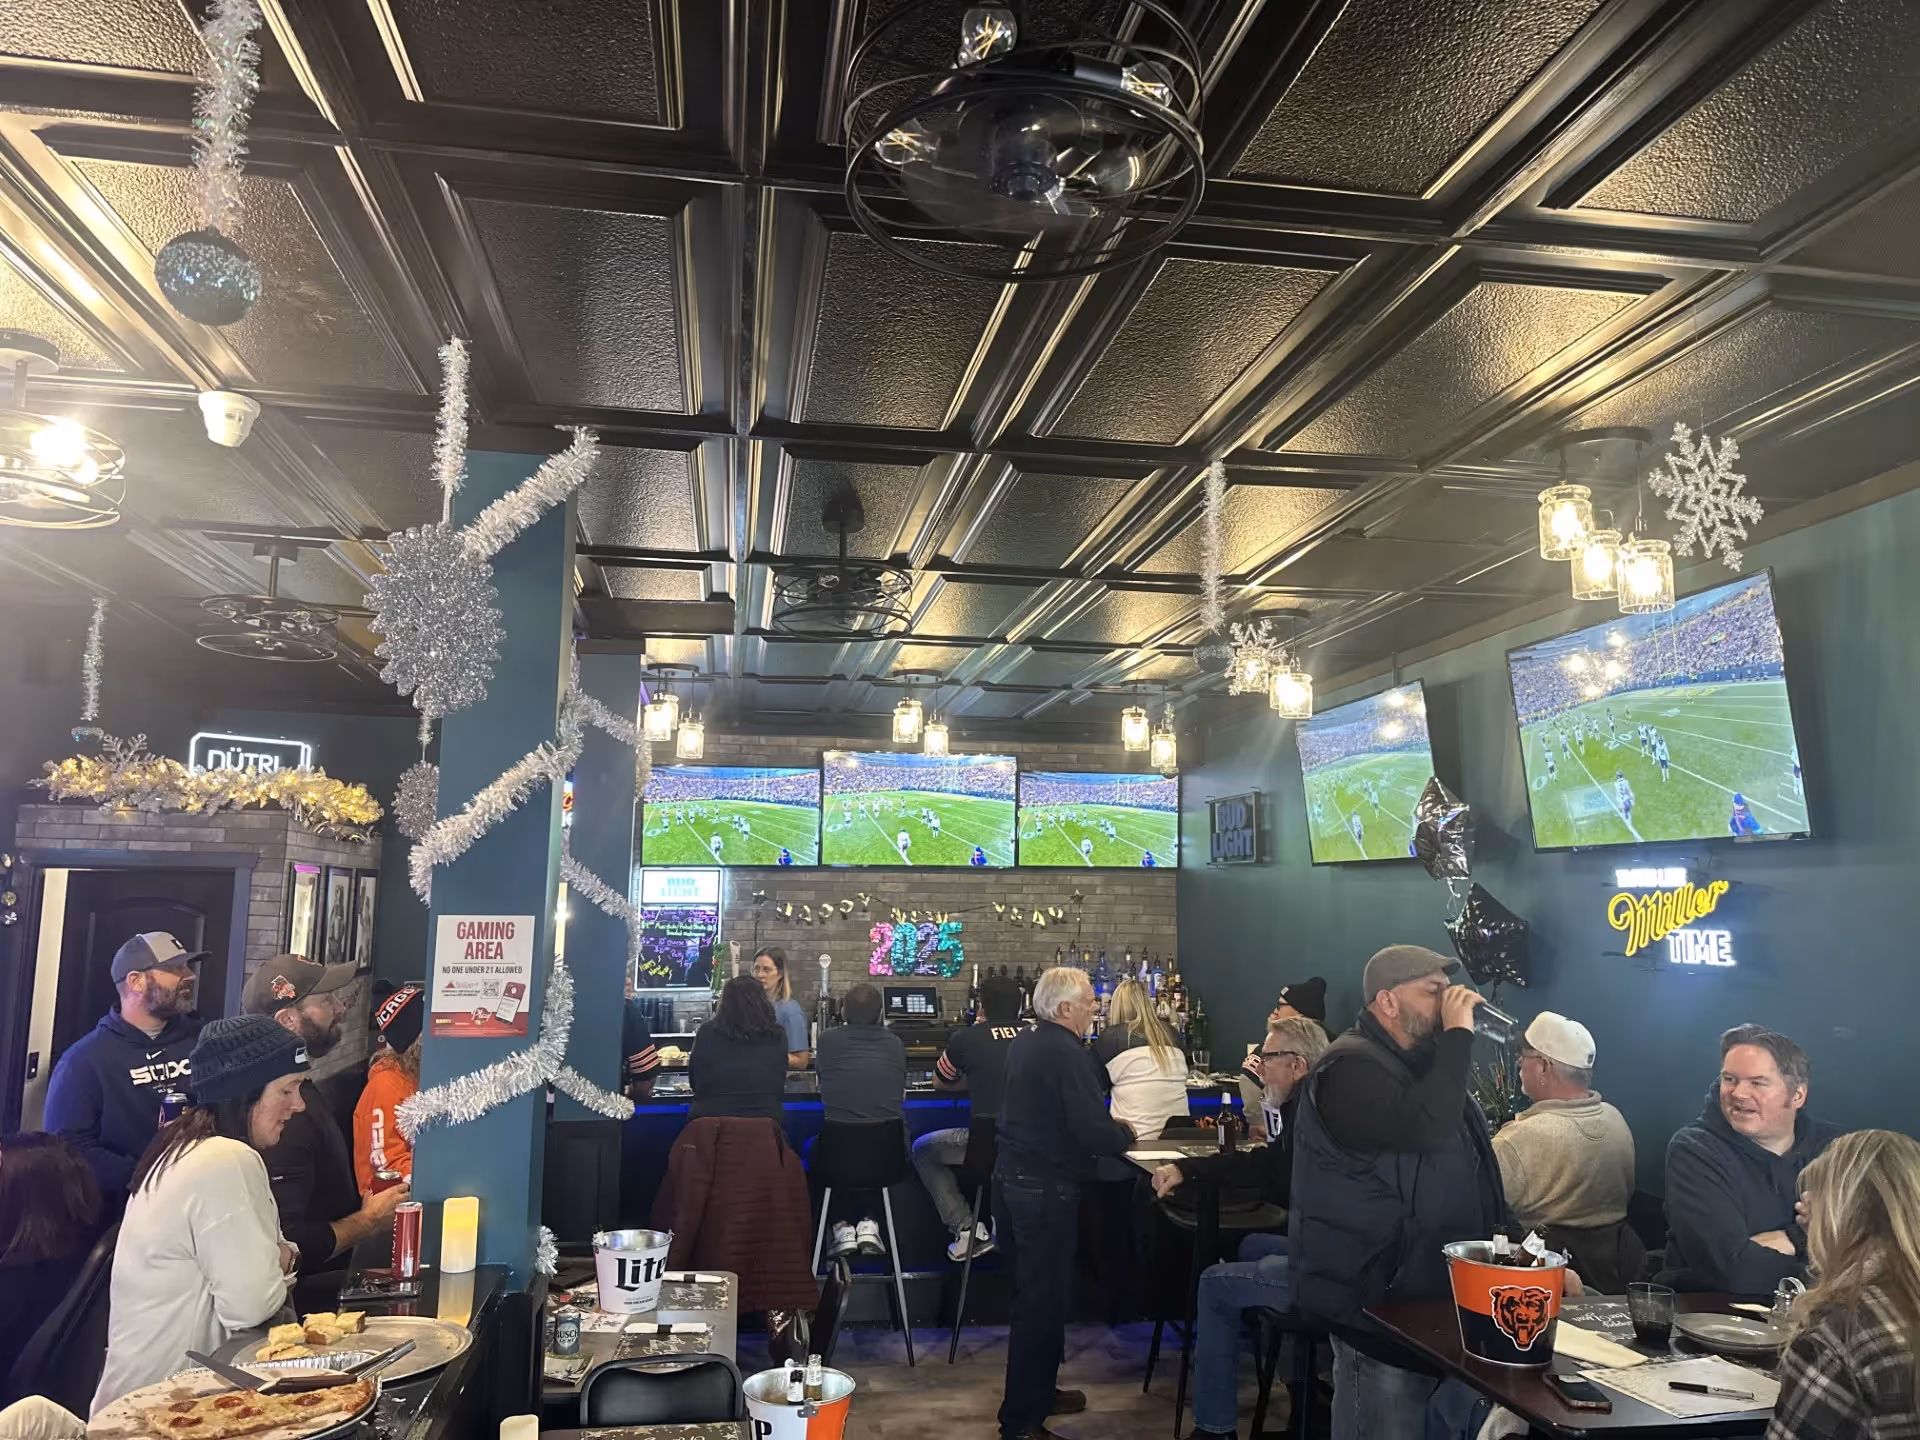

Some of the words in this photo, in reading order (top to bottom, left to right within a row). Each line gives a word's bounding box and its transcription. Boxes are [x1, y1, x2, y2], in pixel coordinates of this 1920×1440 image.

[456, 921, 515, 940] GAMING
[1608, 880, 1729, 957] Miller
[464, 941, 504, 960] AREA
[867, 922, 964, 977] 2025
[1666, 928, 1736, 967] TIME
[442, 966, 451, 974] NO
[451, 966, 464, 974] ONE
[465, 966, 485, 974] UNDER
[485, 966, 494, 974] 21
[494, 966, 523, 974] ALLOWED
[129, 1058, 192, 1086] SOX
